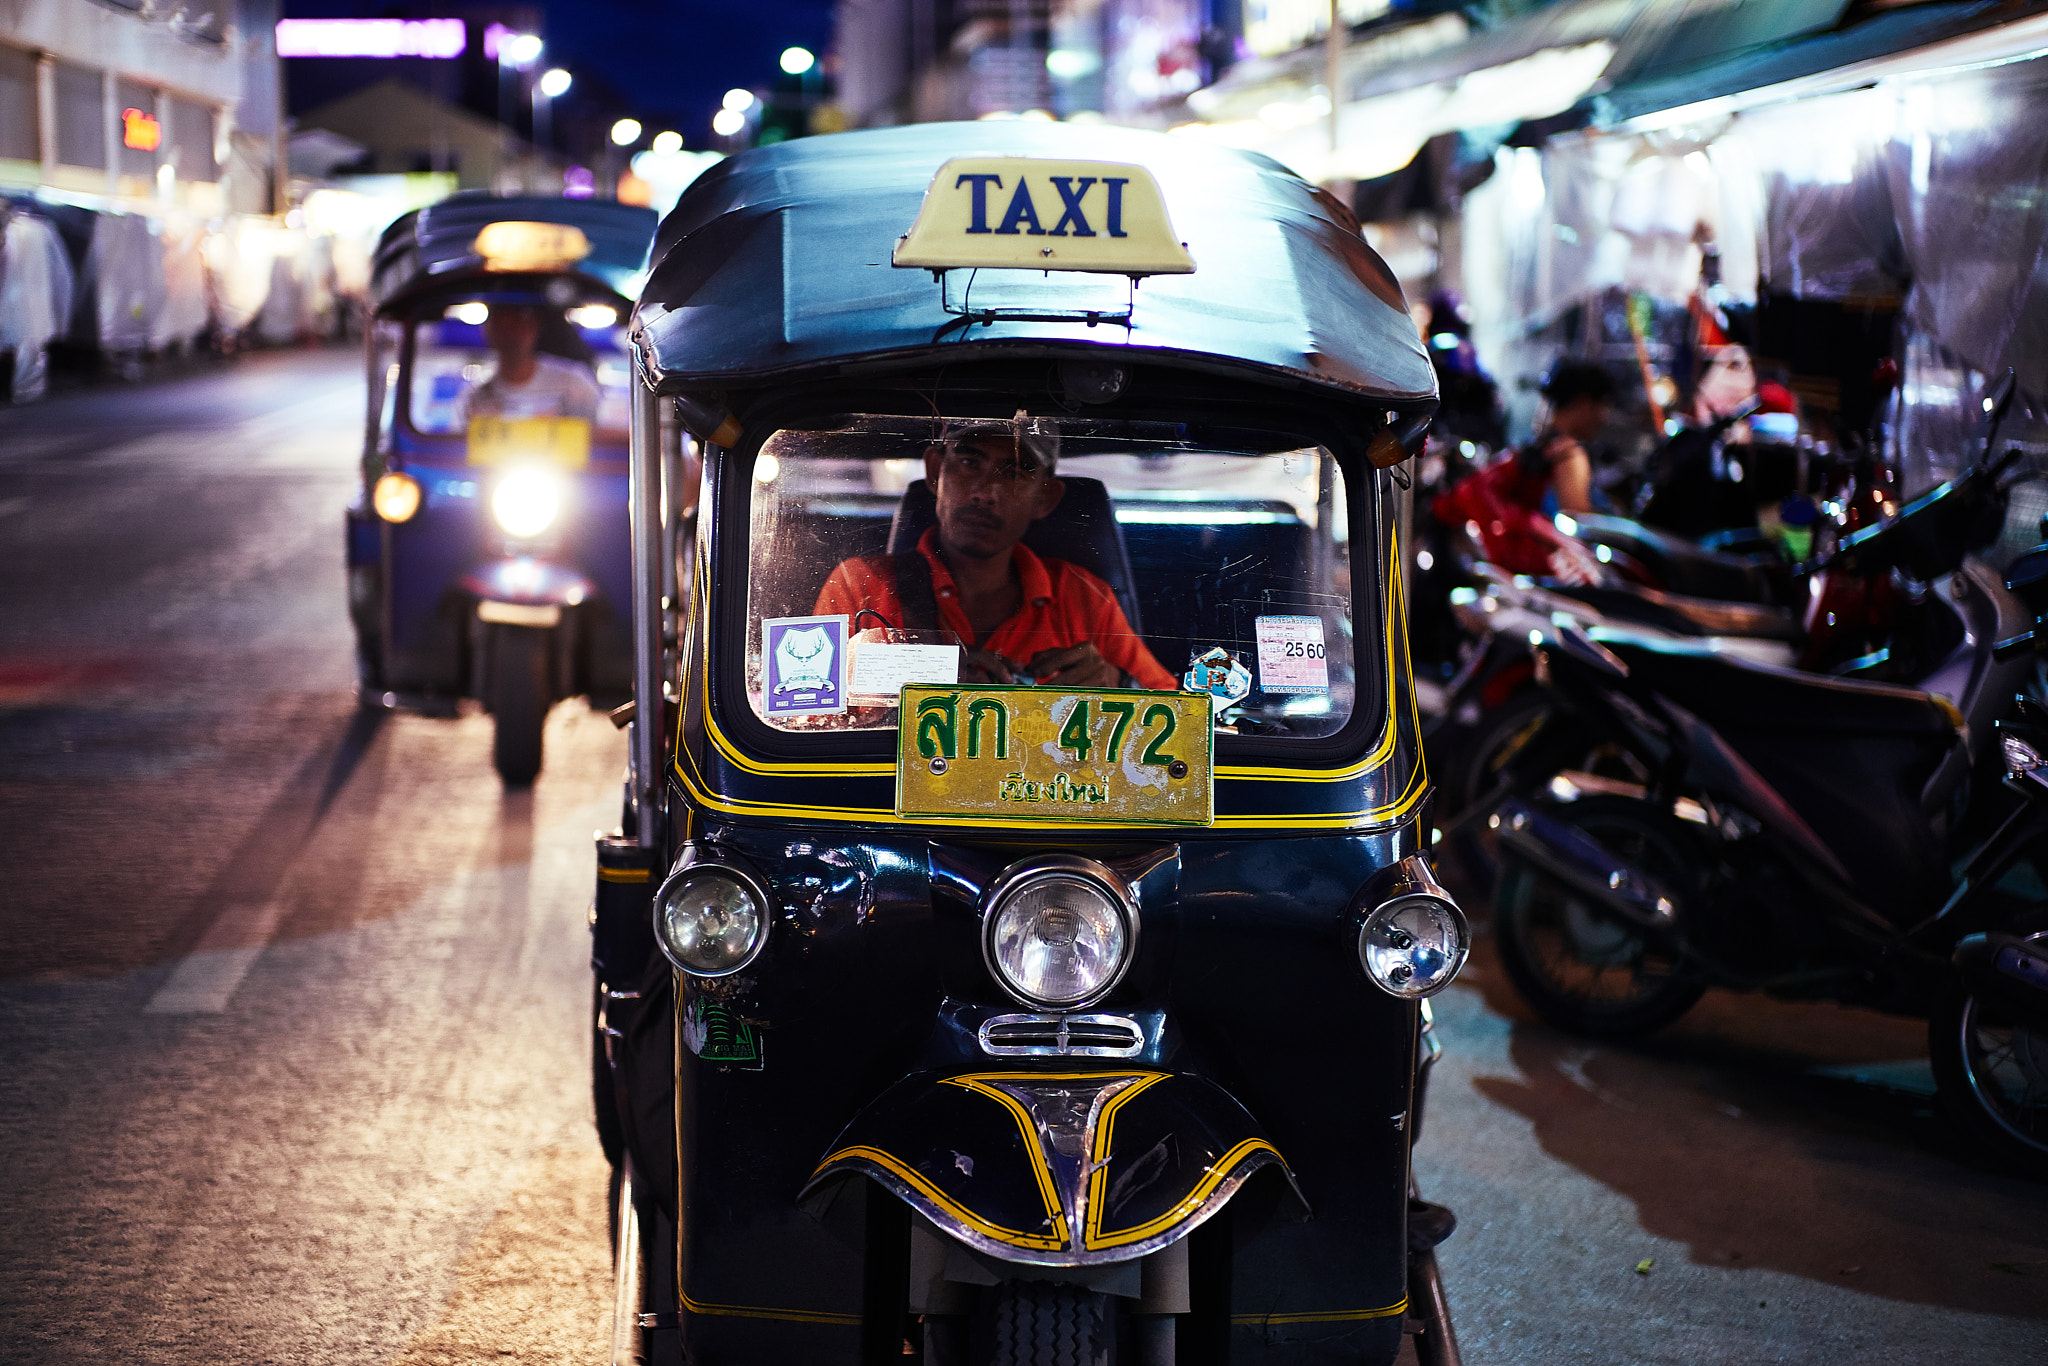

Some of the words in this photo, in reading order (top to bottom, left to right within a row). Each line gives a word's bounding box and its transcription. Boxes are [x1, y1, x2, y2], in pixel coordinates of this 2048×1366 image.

[955, 173, 1130, 238] TAXI
[1285, 641, 1325, 660] 2560
[916, 692, 1010, 760] สก
[1057, 700, 1178, 765] 472
[999, 771, 1110, 805] เชียงใหม่
